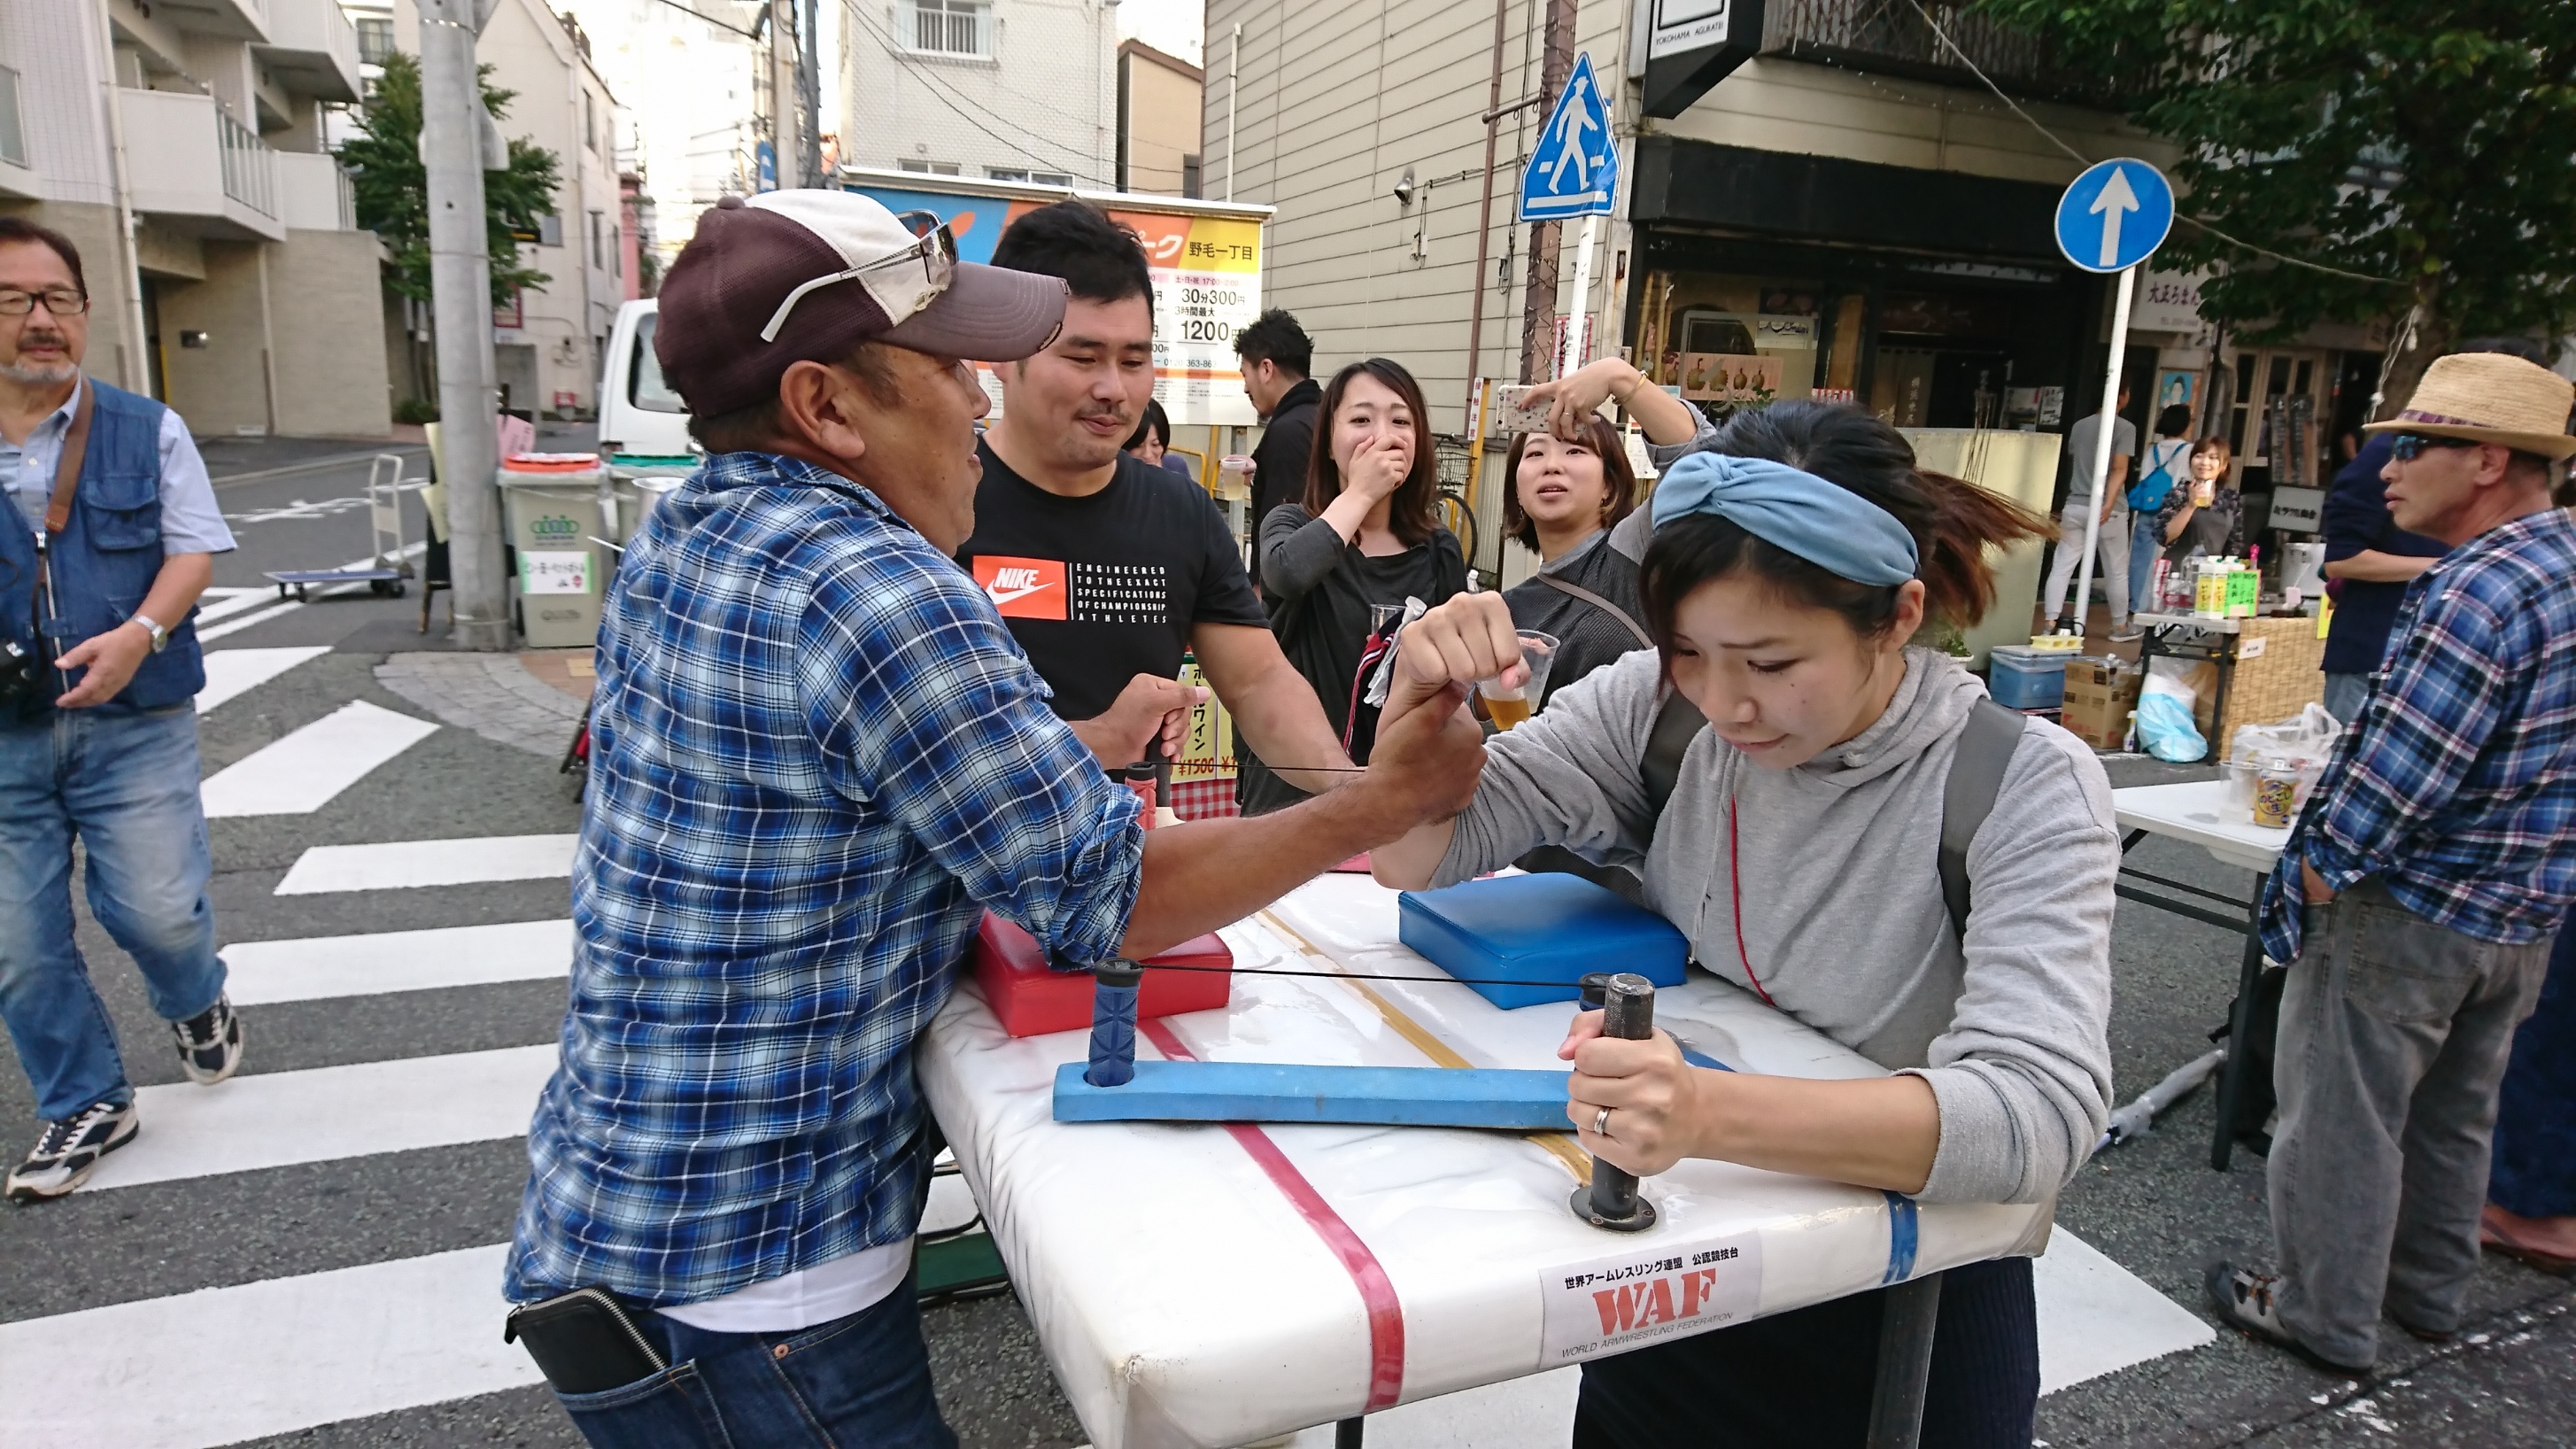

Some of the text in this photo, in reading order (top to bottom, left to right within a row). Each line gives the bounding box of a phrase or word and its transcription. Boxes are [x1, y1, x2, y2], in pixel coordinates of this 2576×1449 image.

[1656, 30, 1690, 45] YOKOHAMA
[1137, 230, 1184, 260] ーク
[1188, 241, 1253, 260] 野毛一丁目
[1174, 306, 1216, 317] 3時間最大
[1076, 562, 1165, 575] ENGINEERED
[994, 568, 1040, 589] NIKE
[1077, 575, 1092, 585] TO
[1098, 577, 1122, 586] THE
[1077, 588, 1166, 599] SPECIFICATIONS
[1078, 601, 1166, 611] OF CHAMPIONSHIP
[1079, 612, 1167, 624] ATHLETES
[1564, 1245, 1739, 1290] 世界アームレスリング連盟 公認競技台
[1591, 1267, 1717, 1337] WAF
[1562, 1311, 1734, 1358] WORLD ARMWRESTLING FEDERATION
